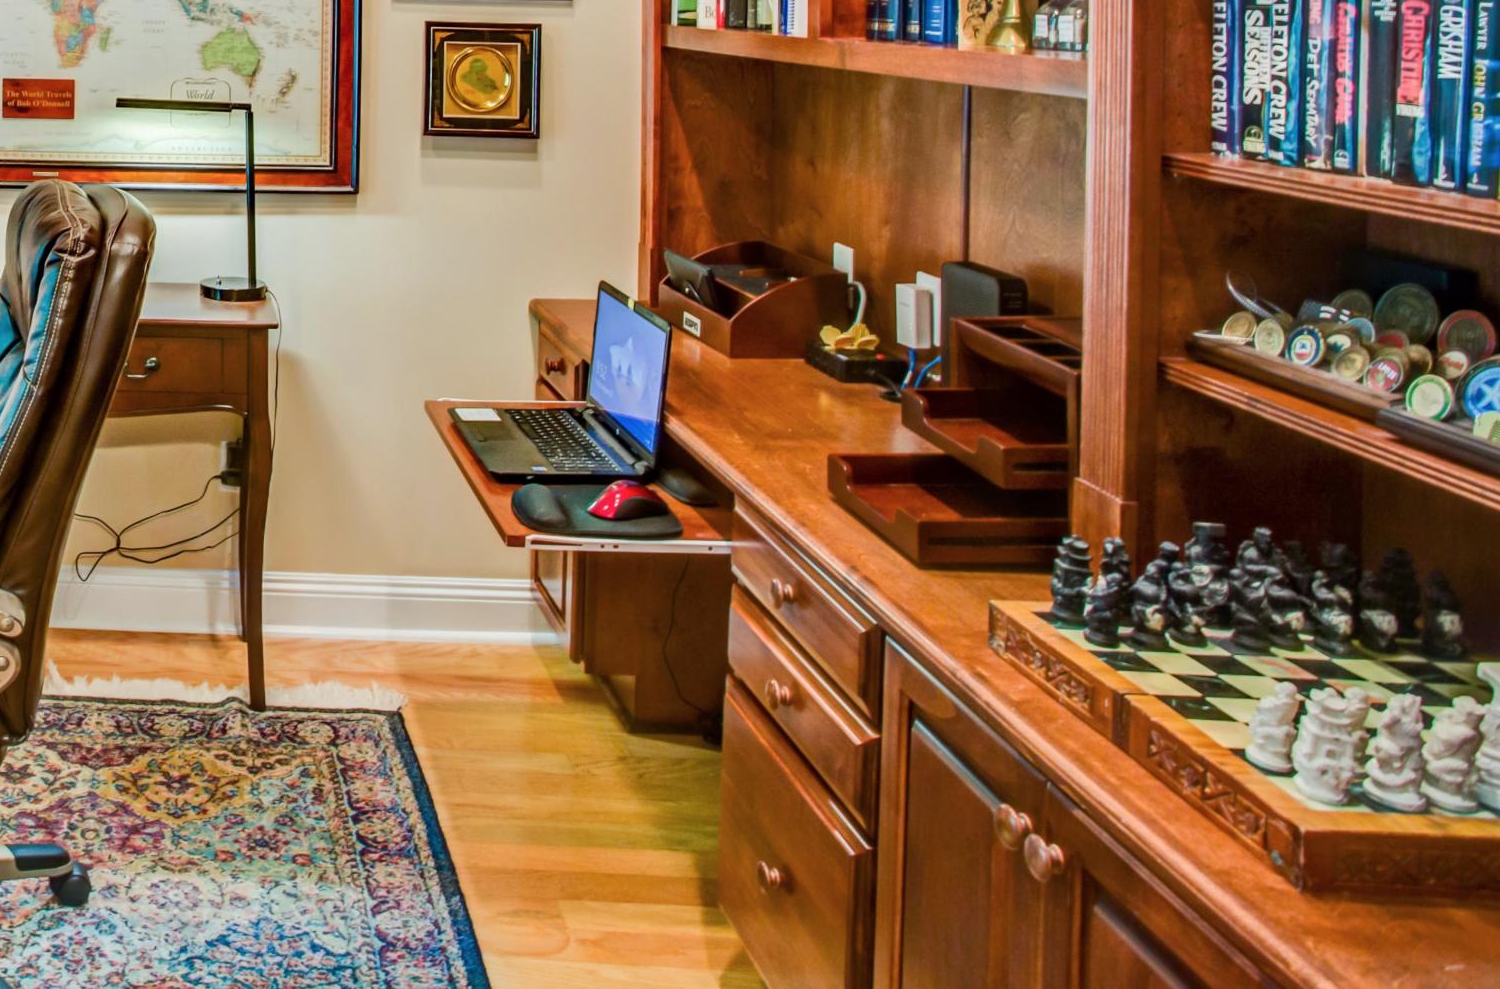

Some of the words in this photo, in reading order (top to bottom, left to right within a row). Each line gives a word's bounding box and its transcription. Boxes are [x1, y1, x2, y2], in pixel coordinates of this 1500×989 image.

[1397, 0, 1430, 104] CHRISTINE
[1438, 4, 1467, 80] GRISHAM
[1475, 2, 1494, 51] LAWYER
[1243, 9, 1264, 106] SEASONS
[1473, 57, 1489, 99] JOHN
[5, 89, 20, 99] The
[21, 89, 45, 99] World
[46, 90, 73, 99] Travels
[7, 99, 16, 108] of
[16, 99, 31, 108] Bob
[32, 99, 71, 109] O'Donnell
[184, 88, 216, 102] World
[1211, 75, 1228, 132] CREW
[1268, 81, 1288, 140] CREW
[1470, 101, 1485, 167] GRISHAM
